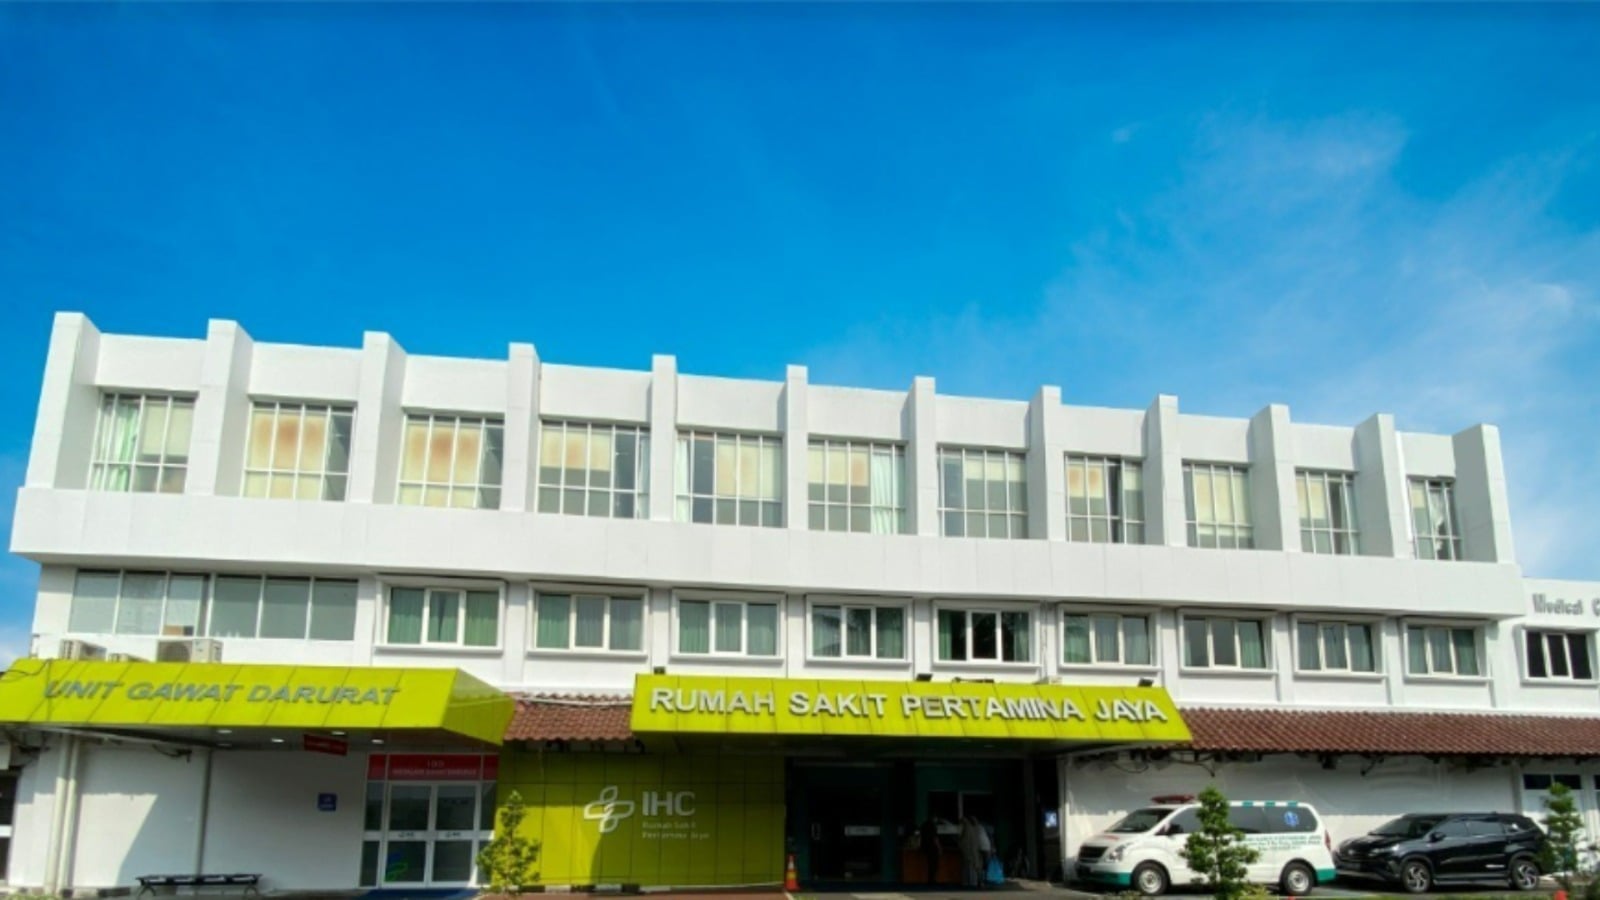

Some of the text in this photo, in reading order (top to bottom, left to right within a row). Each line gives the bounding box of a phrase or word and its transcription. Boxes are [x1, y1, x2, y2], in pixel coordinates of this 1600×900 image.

[1532, 593, 1583, 615] Medical
[44, 680, 401, 705] UNIT GAWAT DARURAT
[650, 687, 1168, 722] RUMAH SAKIT PERTAMINA JAYA
[642, 791, 696, 816] IHC
